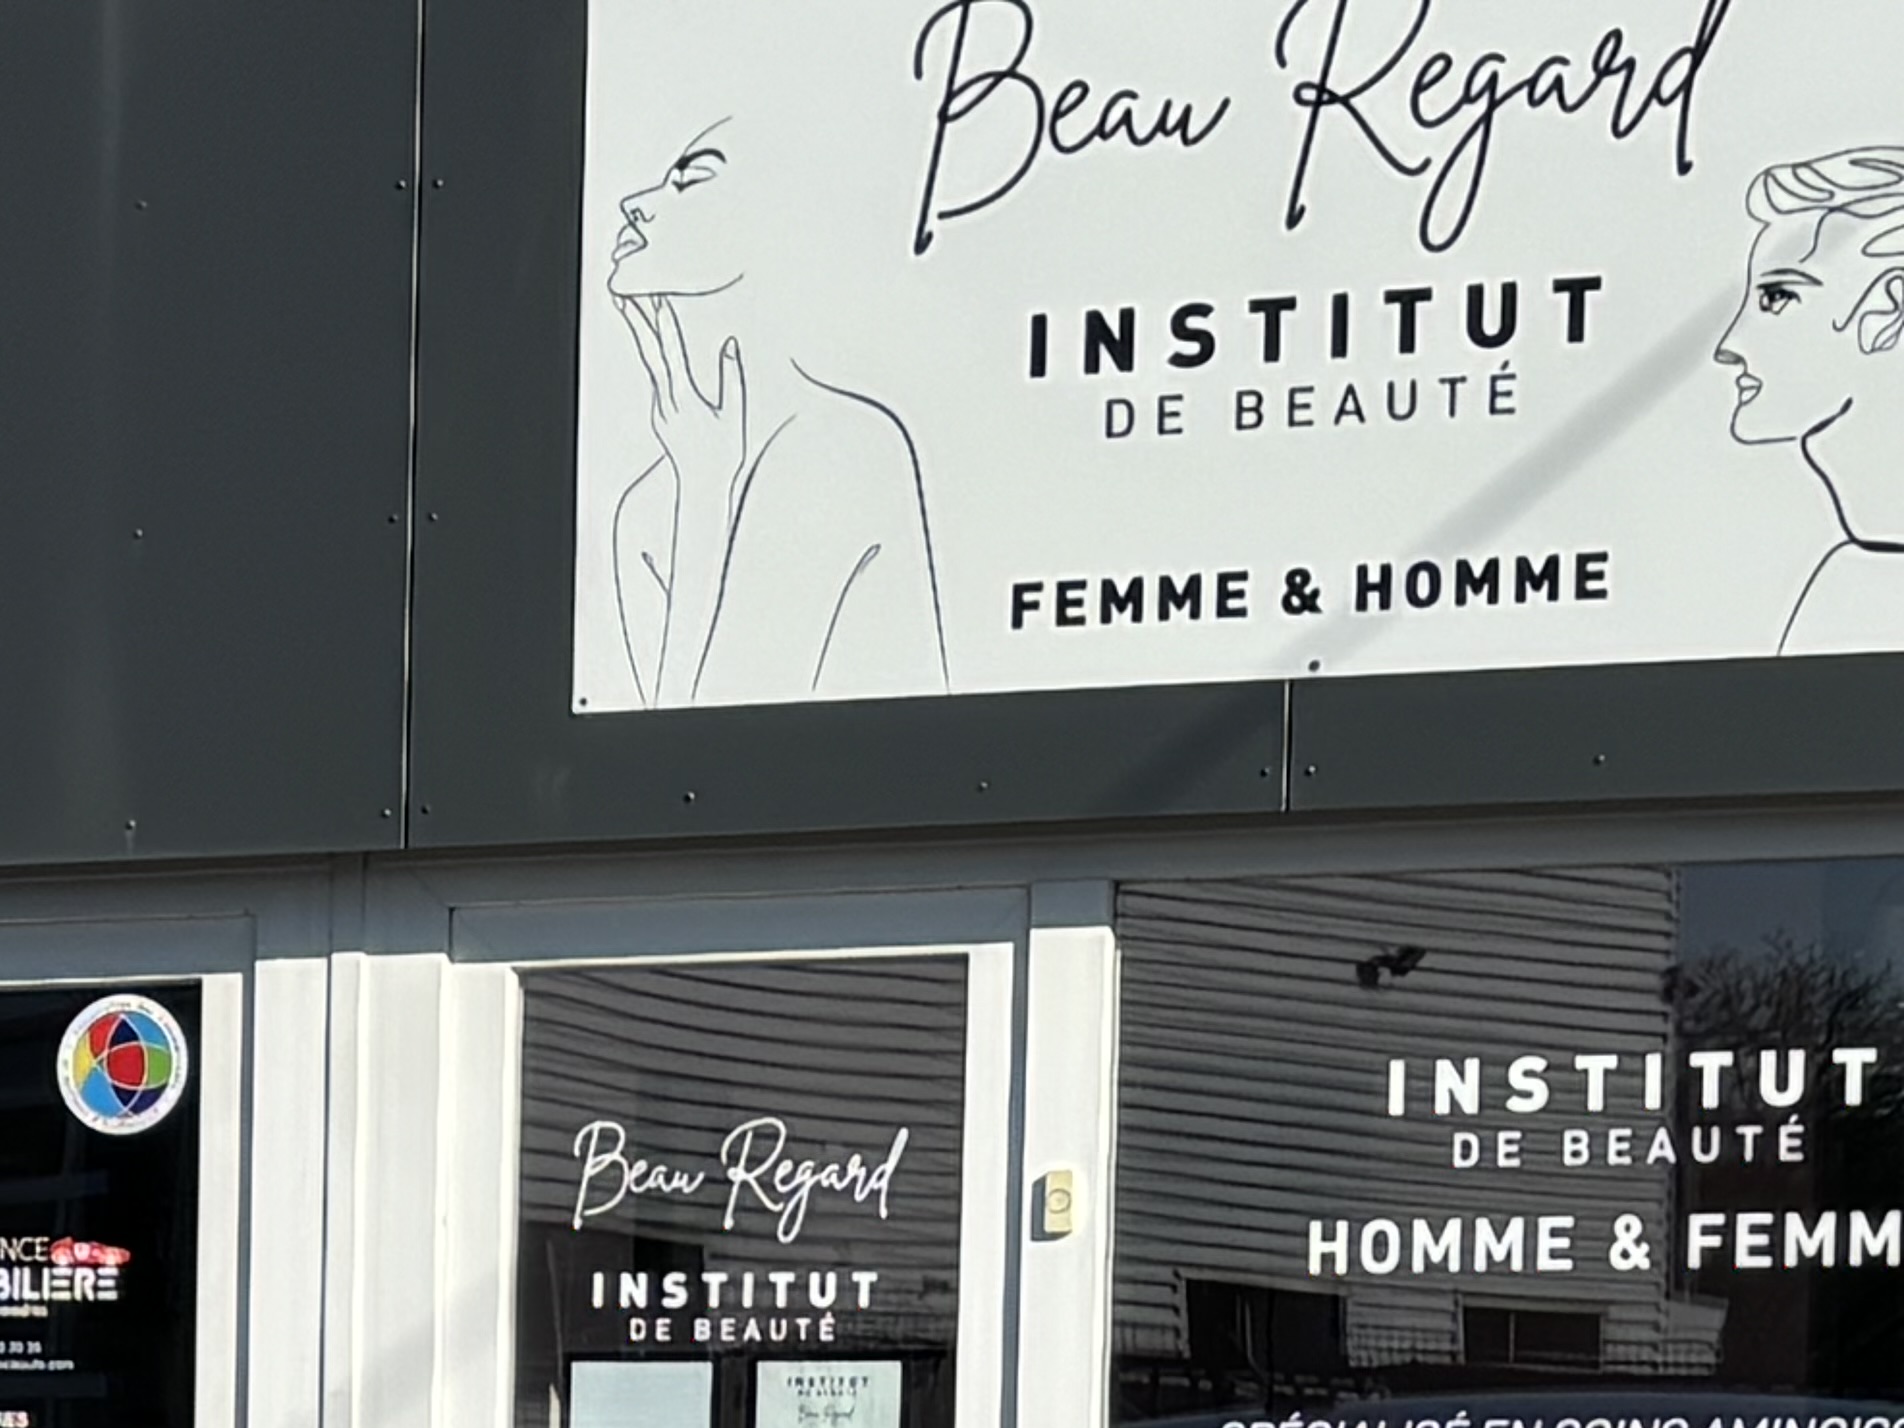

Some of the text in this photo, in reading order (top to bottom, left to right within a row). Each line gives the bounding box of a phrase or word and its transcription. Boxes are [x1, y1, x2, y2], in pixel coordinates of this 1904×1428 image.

[914, 0, 1730, 255] Beau Regard
[1030, 276, 1603, 379] INSTITUT
[1106, 361, 1517, 438] DE BEAUTÉ
[1012, 552, 1608, 629] FEMME & HOMME
[1389, 1048, 1877, 1116] INSTITUT
[1453, 1115, 1803, 1167] DE BEAUTÉ
[573, 1117, 908, 1243] Beau Regard
[1309, 1216, 1574, 1275] HOMME
[1610, 1214, 1649, 1270] &
[593, 1272, 877, 1308] INSTITUT
[630, 1312, 835, 1341] DE BEAUTÉ
